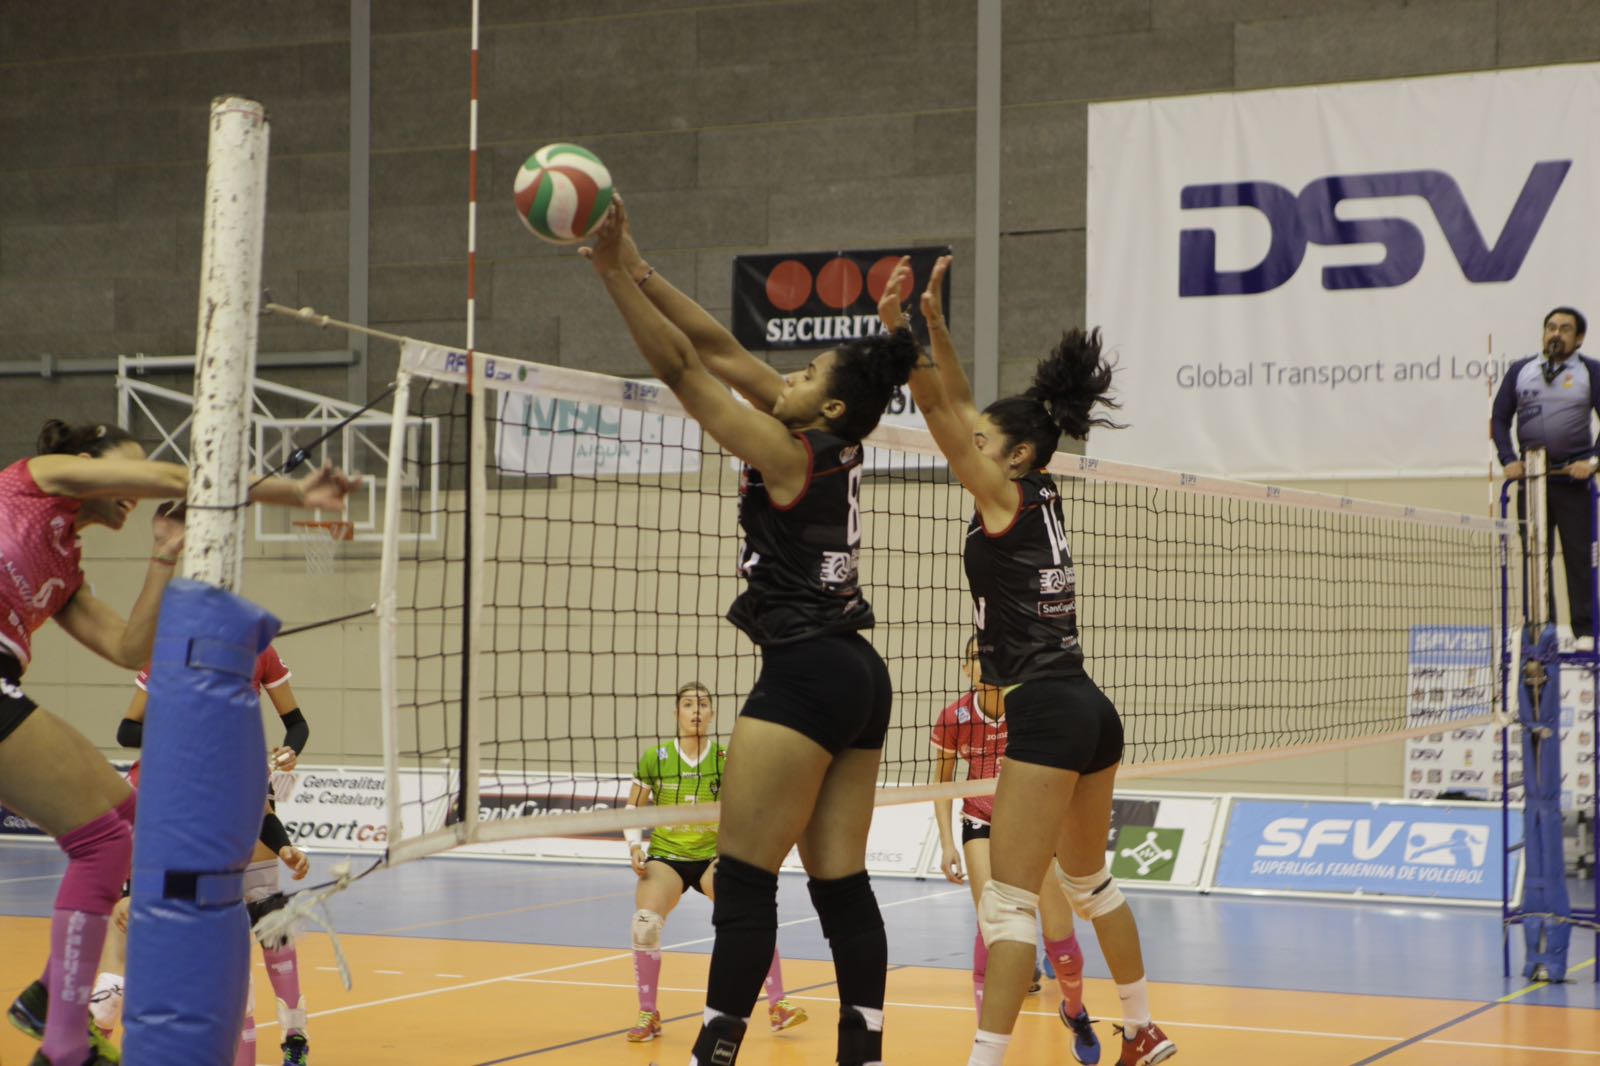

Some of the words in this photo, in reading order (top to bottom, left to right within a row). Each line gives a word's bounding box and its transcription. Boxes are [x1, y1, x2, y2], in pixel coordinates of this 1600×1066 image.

[1180, 159, 1572, 297] DSV
[1176, 361, 1253, 388] Global
[1261, 361, 1384, 390] Transport
[1394, 354, 1440, 381] and
[847, 464, 863, 546] 8
[1041, 499, 1071, 566] 14
[294, 791, 314, 803] de
[319, 791, 385, 810] Cataluny
[1254, 816, 1405, 861] SFV
[1250, 859, 1323, 877] SUPERLIGA
[1324, 862, 1394, 880] FEMENINA
[1397, 866, 1415, 881] DE
[1418, 867, 1484, 885] VOLEIBOL
